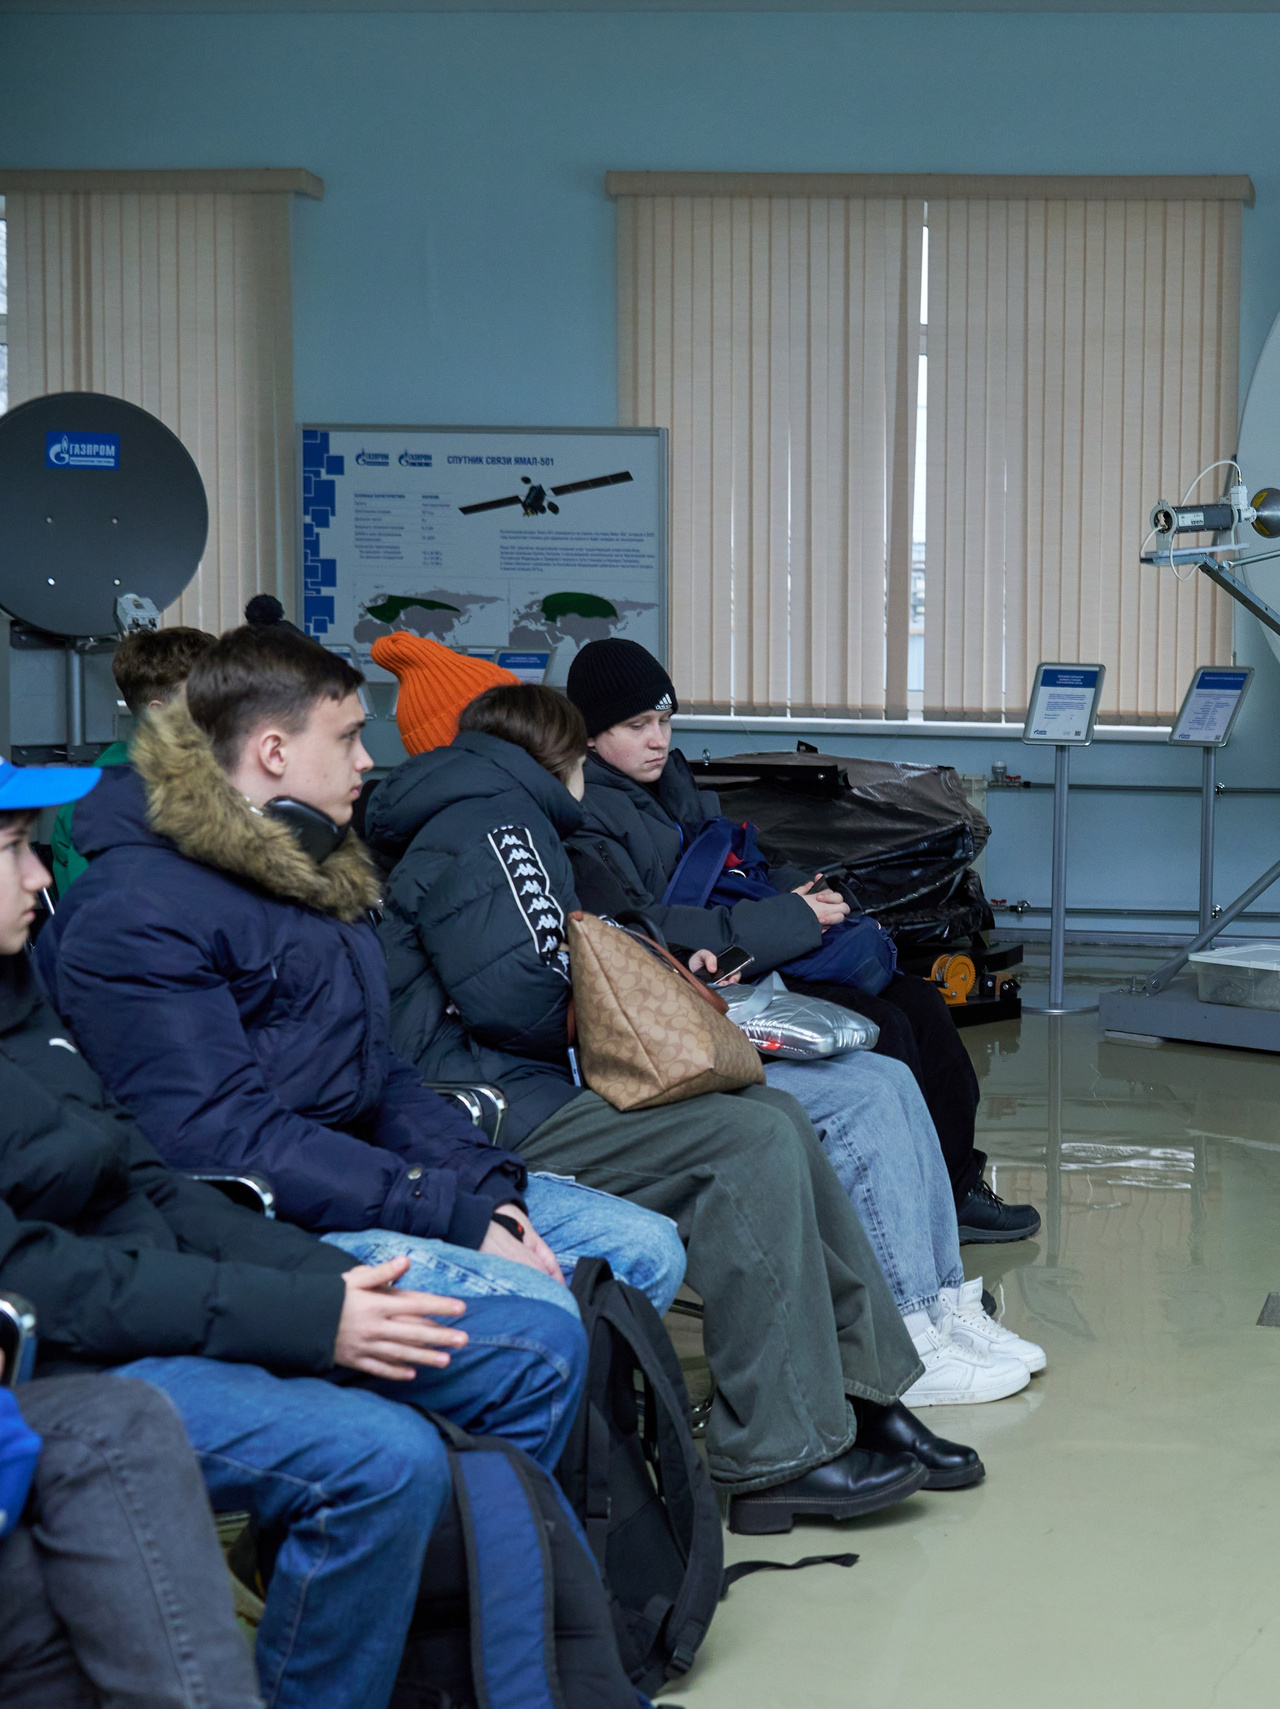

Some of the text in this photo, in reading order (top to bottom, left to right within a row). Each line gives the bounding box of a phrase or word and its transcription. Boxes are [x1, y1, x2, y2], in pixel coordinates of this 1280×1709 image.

[69, 443, 115, 457] ГАЗПРОМ
[447, 455, 554, 466] СПУТНИК СВЯЗИ ЯМАЛ-501
